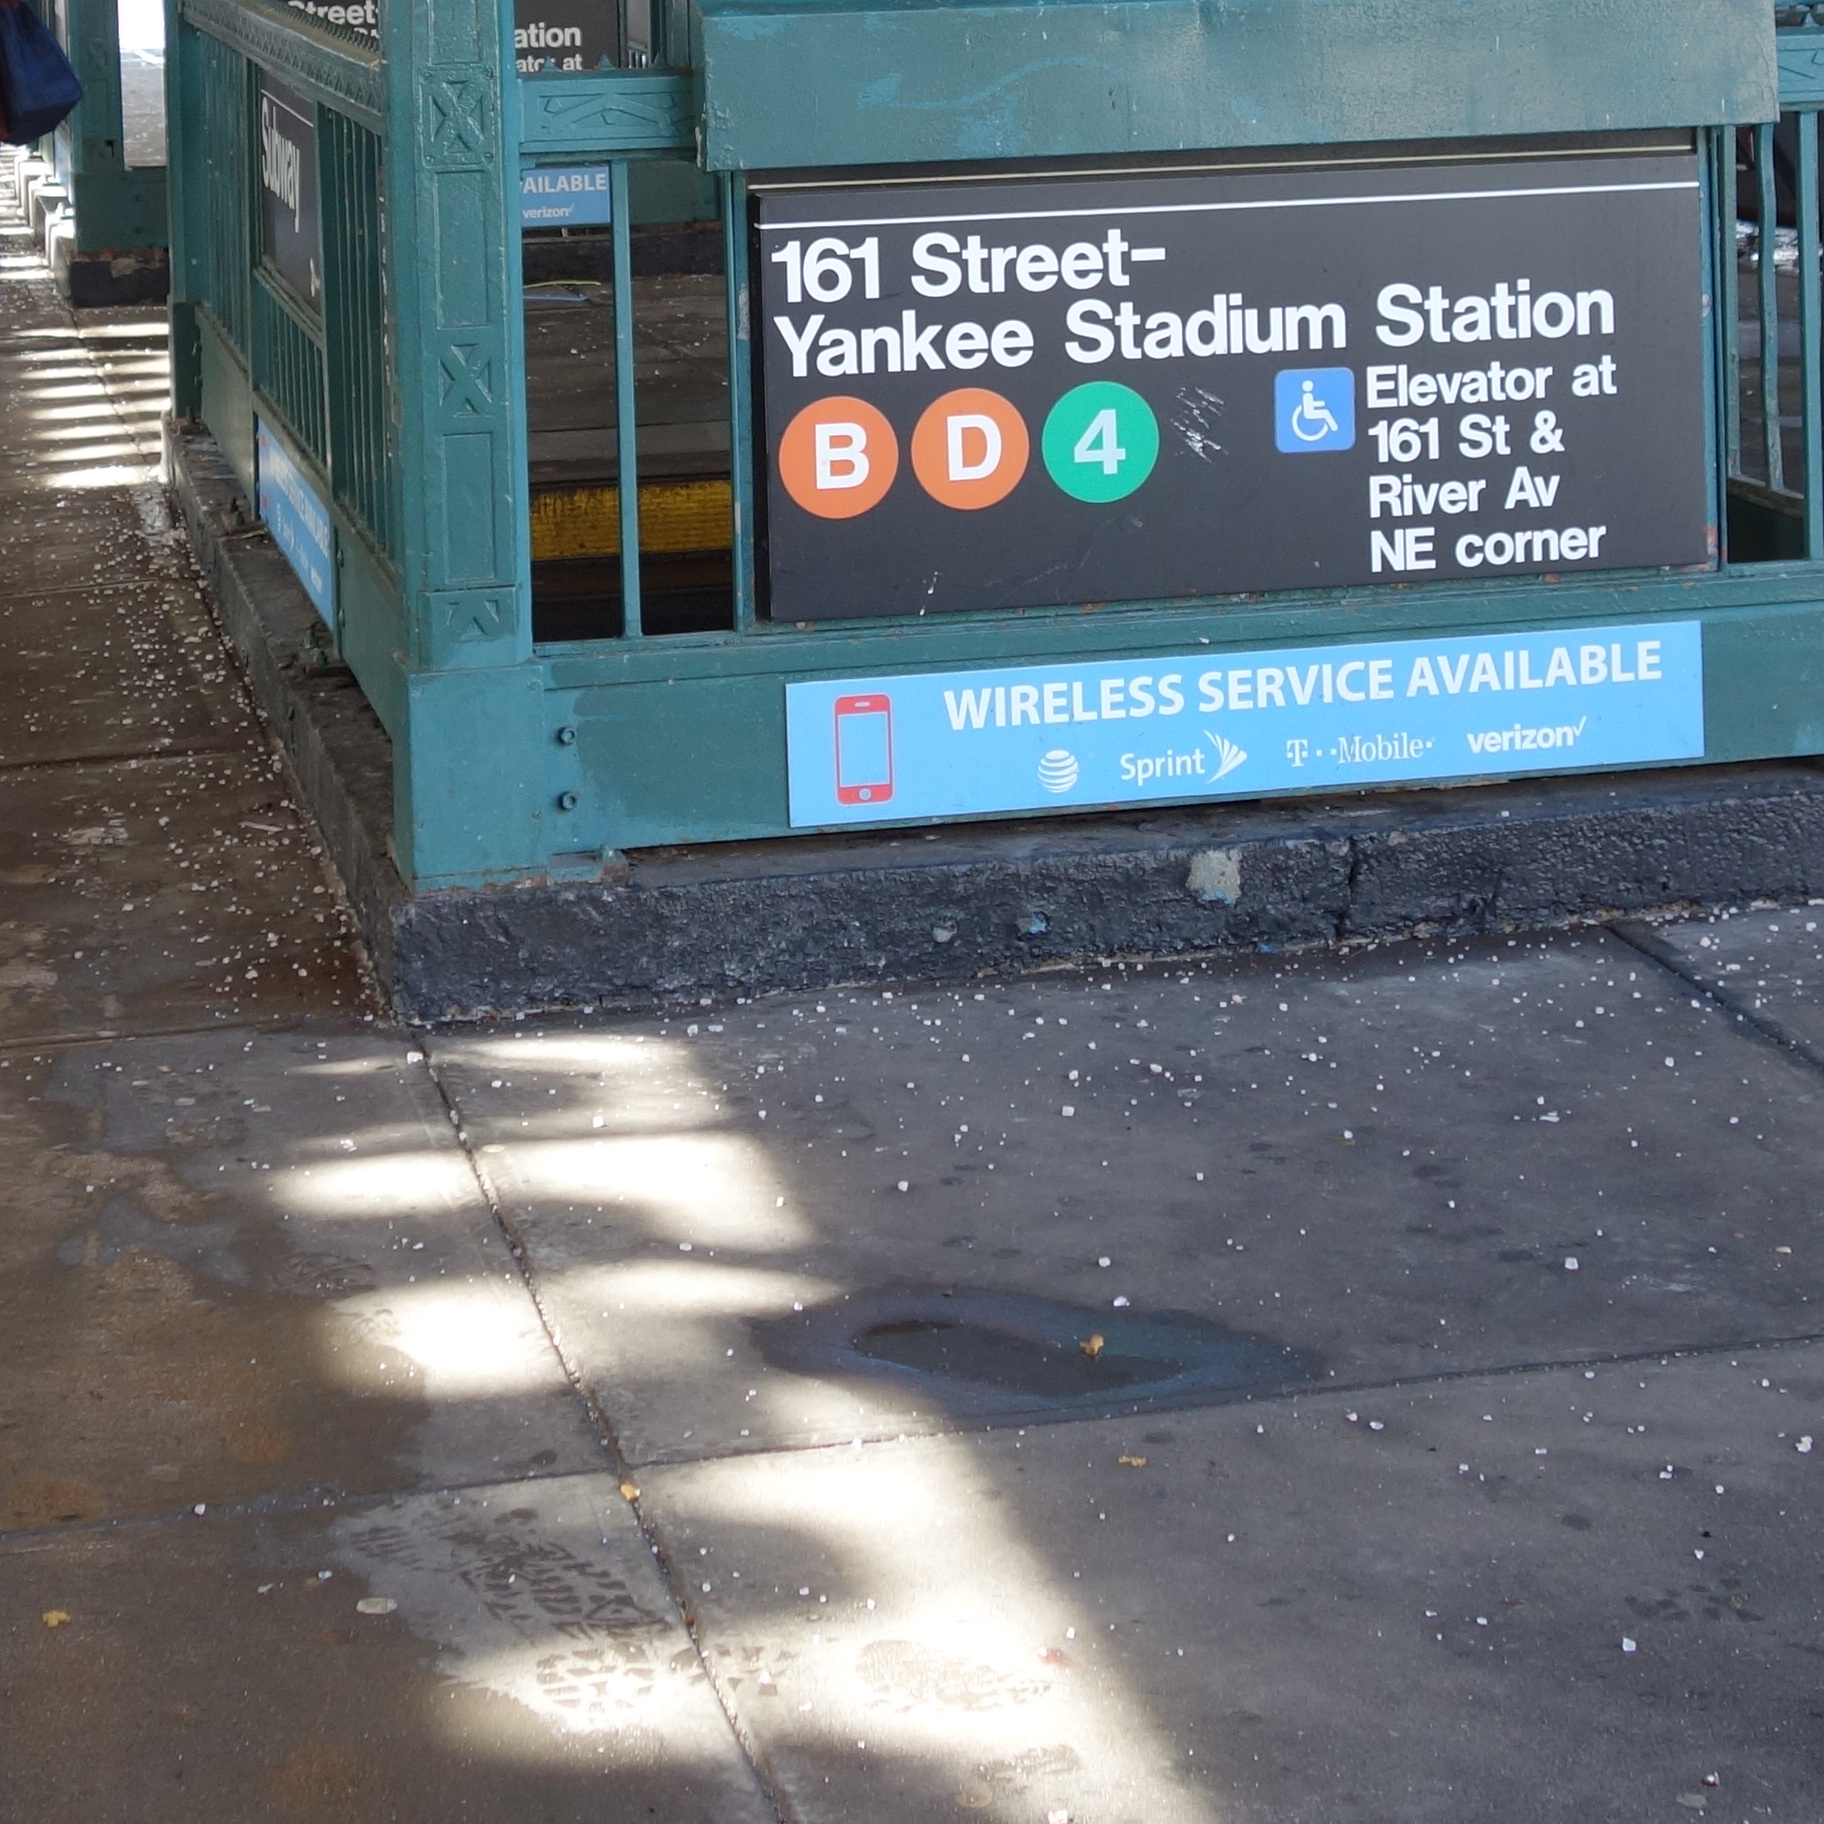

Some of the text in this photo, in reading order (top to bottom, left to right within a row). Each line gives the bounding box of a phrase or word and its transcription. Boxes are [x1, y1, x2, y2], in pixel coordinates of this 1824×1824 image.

[514, 22, 582, 48] ation
[261, 96, 301, 234] Subway
[520, 173, 608, 194] AILABLE
[522, 204, 571, 219] verizon
[770, 228, 1167, 304] 161 Street-
[772, 278, 1616, 378] Yankee Stadium Station
[1366, 354, 1618, 409] Elevator at
[814, 408, 1127, 490] B D 4
[1367, 409, 1566, 463] 161 St &
[1369, 465, 1561, 518] River Av
[1370, 524, 1608, 573] NE corner
[943, 640, 1663, 731] WIRELESS SERVICE AVAILABLE
[1119, 747, 1206, 787] Sprint
[1467, 723, 1575, 754] verizon
